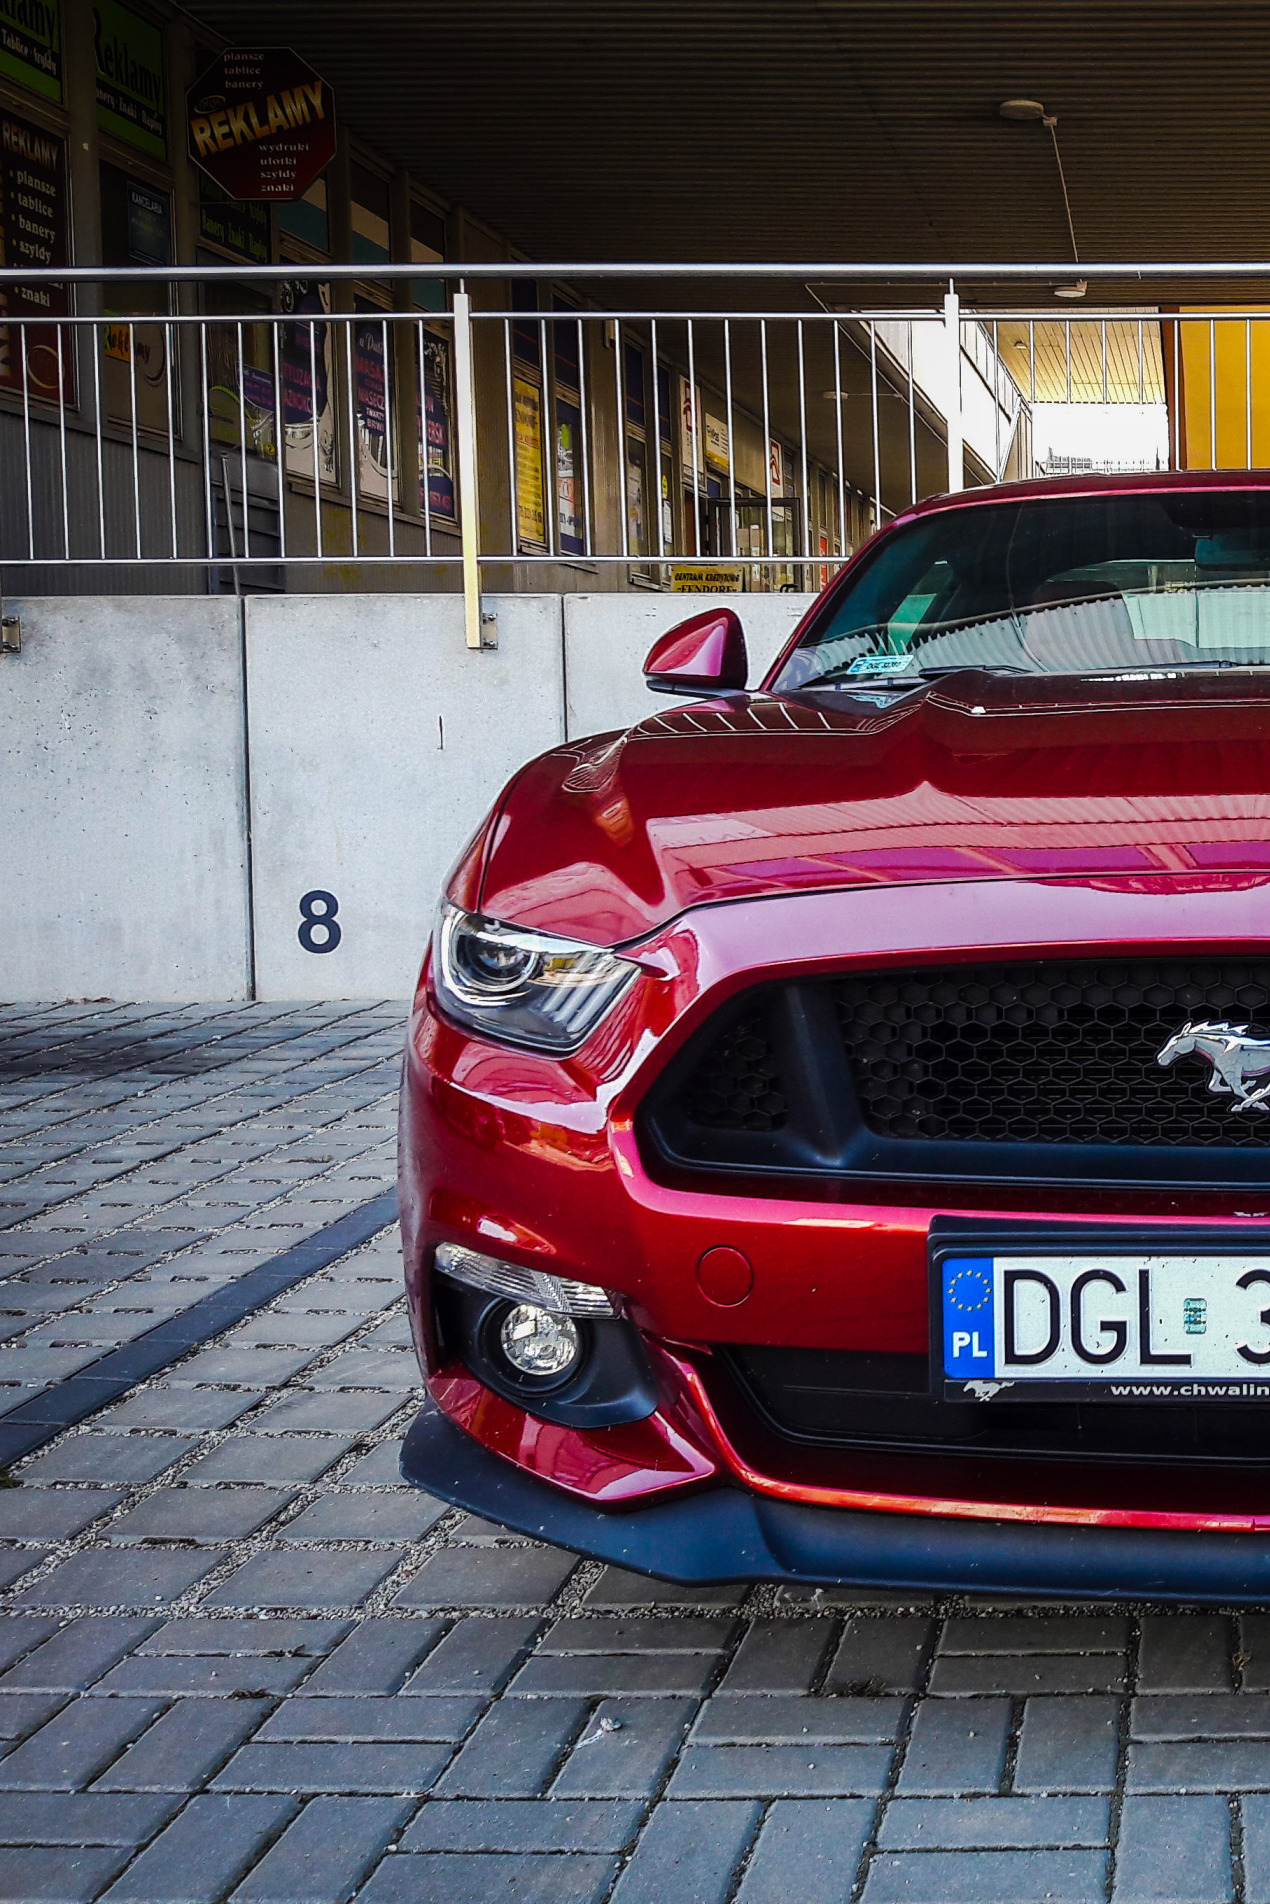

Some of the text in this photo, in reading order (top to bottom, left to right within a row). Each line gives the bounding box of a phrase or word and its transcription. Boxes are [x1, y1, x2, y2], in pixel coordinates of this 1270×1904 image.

[223, 52, 264, 62] plansze
[224, 66, 261, 75] tablice
[225, 80, 264, 90] banery
[190, 80, 325, 157] REKLAMY
[2, 120, 58, 170] REKLAMY
[258, 142, 310, 153] wydruki
[260, 156, 297, 166] ulotki
[16, 169, 57, 198] plansze
[260, 170, 297, 180] szyldy
[260, 183, 295, 193] znaki
[17, 192, 54, 219] tablice
[18, 214, 56, 244] banery
[19, 239, 52, 266] szyldy
[21, 286, 50, 307] znaki
[298, 890, 341, 954] 8
[1004, 1268, 1192, 1366] DGL
[953, 1331, 988, 1358] PL
